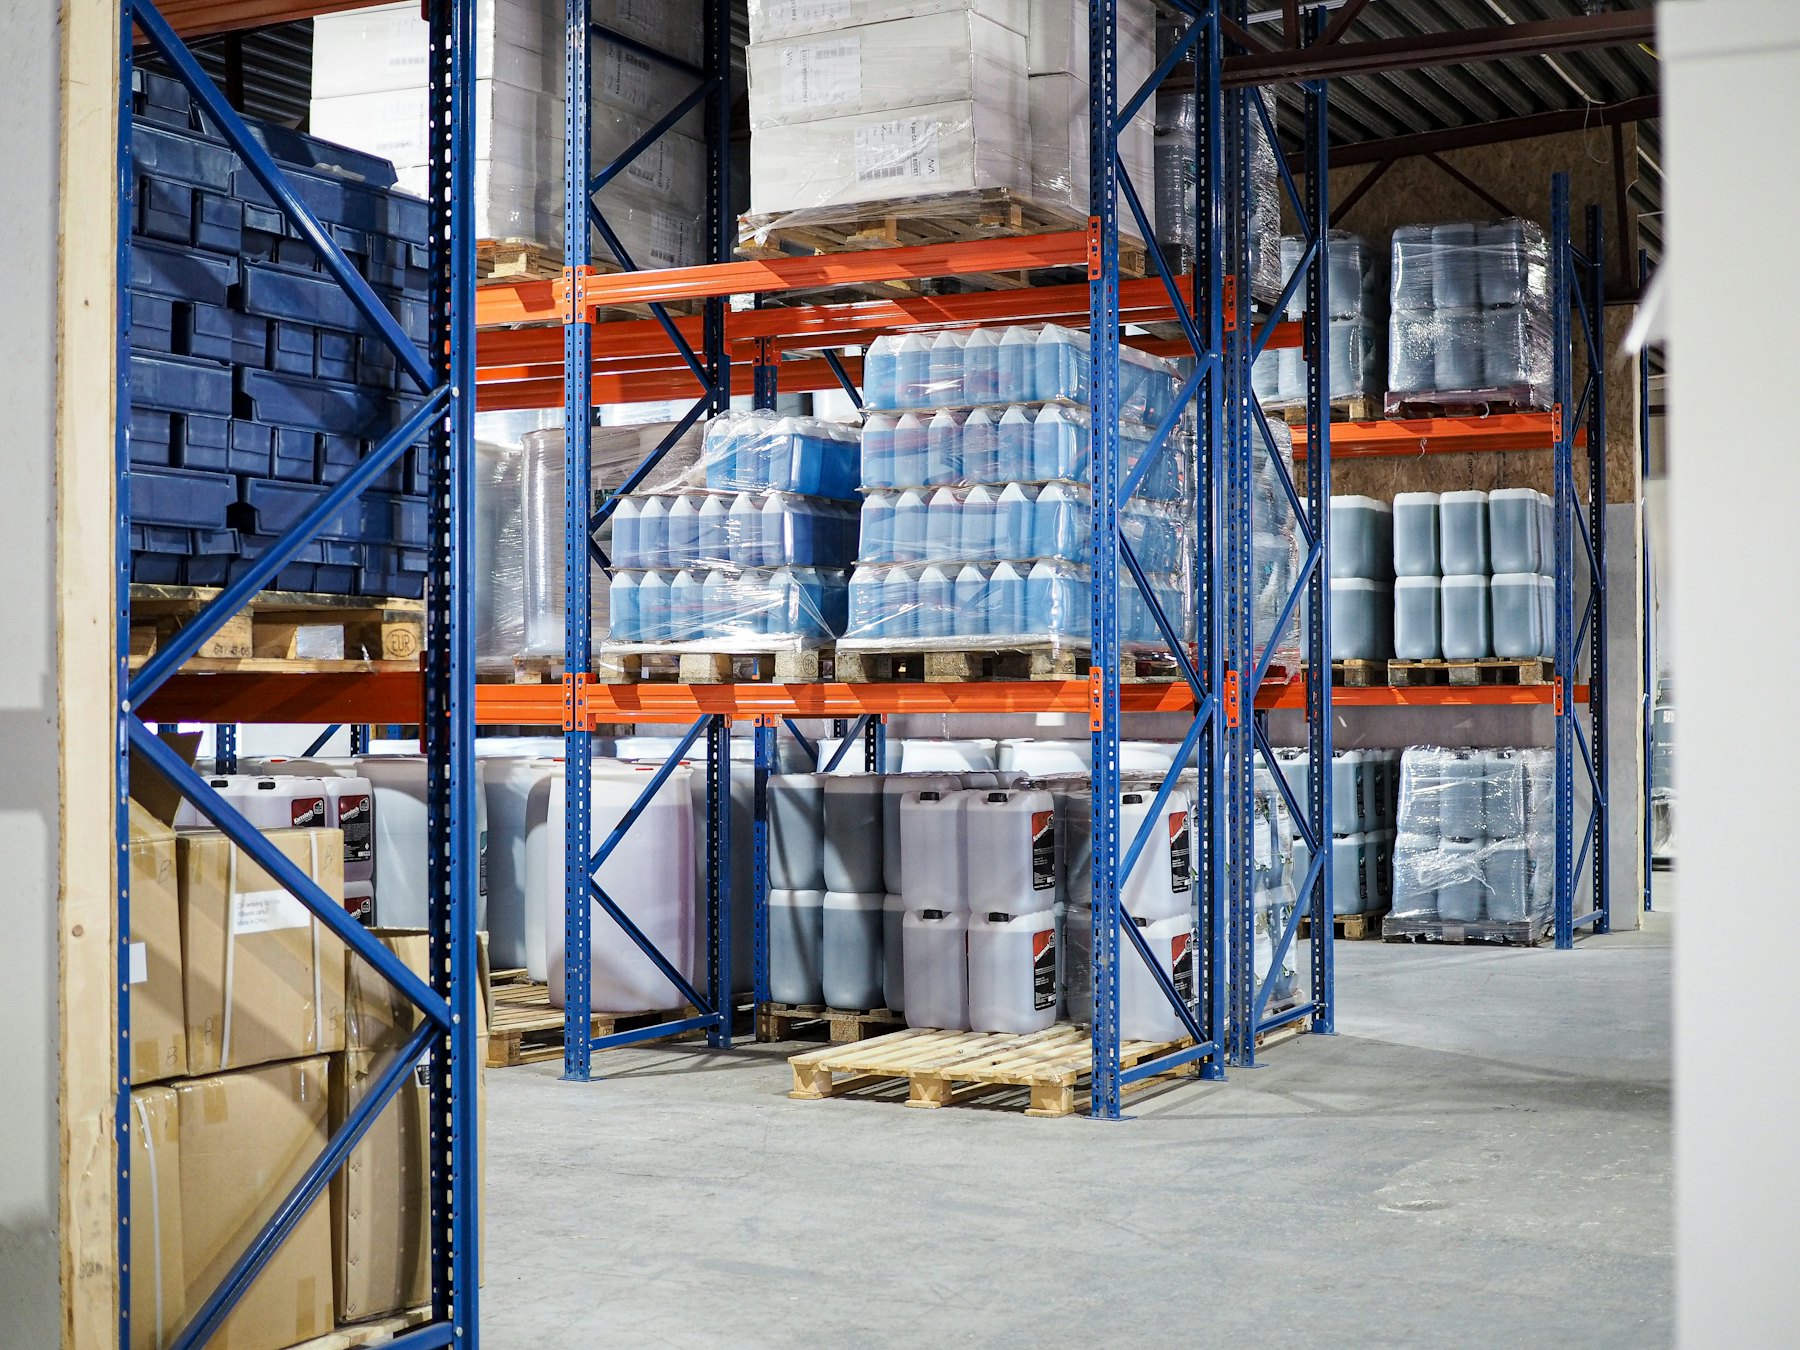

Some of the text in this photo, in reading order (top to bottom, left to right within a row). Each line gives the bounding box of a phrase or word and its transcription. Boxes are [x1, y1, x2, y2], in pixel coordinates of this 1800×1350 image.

[927, 158, 935, 175] AVA
[391, 633, 411, 651] EUR
[157, 860, 172, 884] B
[165, 1046, 178, 1067] B
